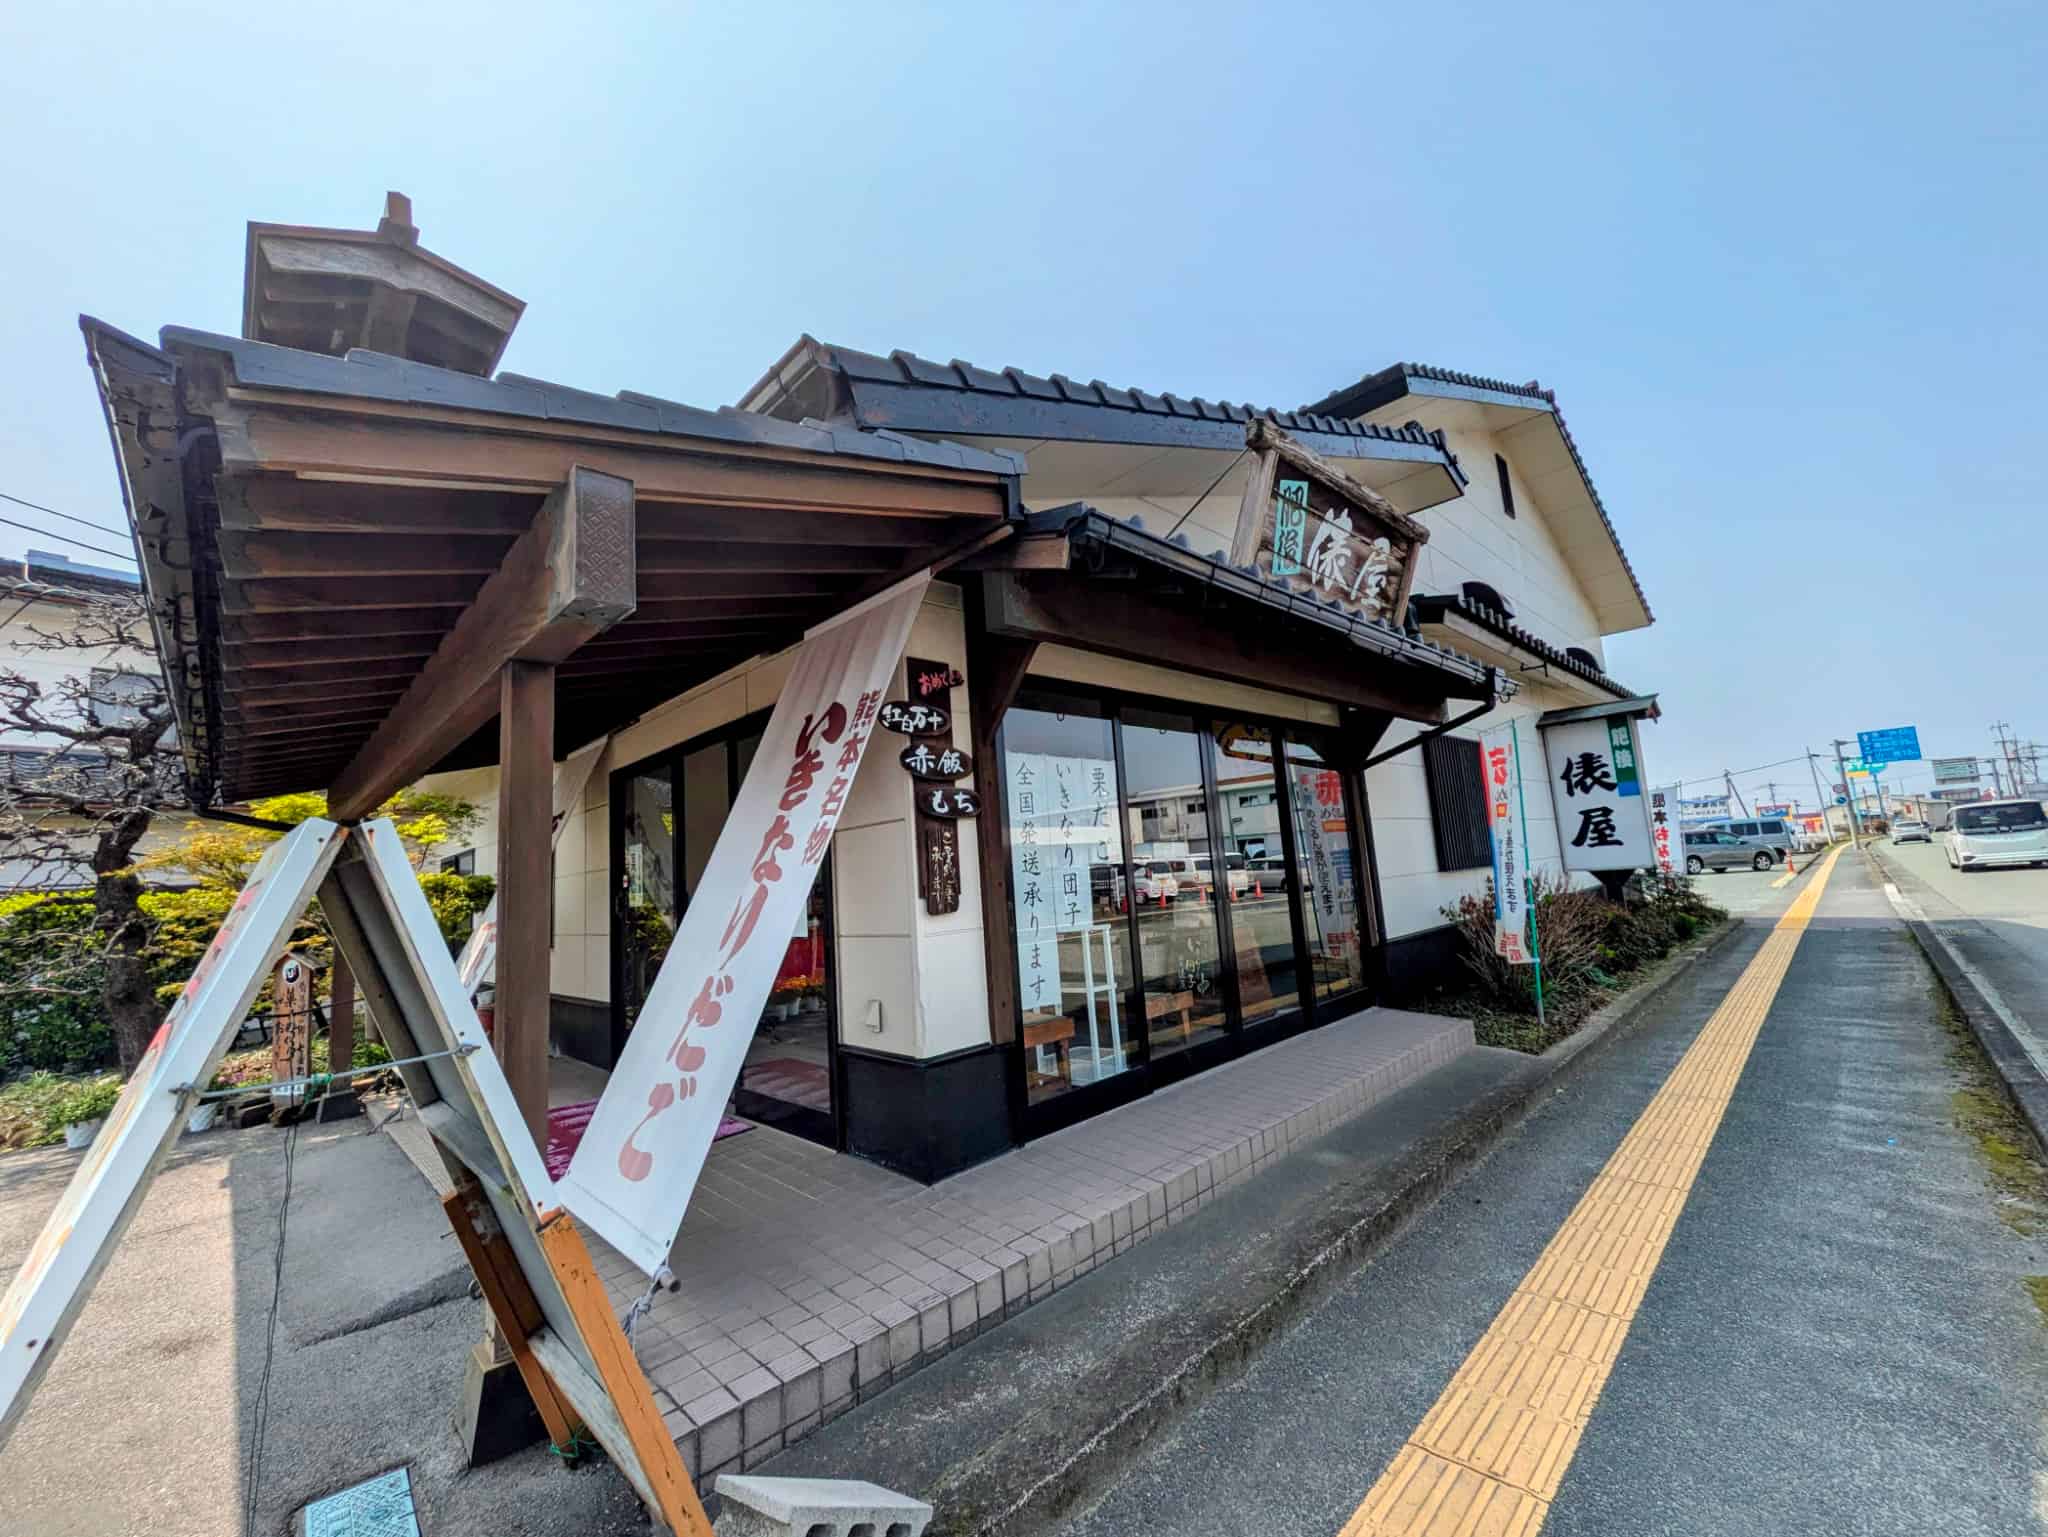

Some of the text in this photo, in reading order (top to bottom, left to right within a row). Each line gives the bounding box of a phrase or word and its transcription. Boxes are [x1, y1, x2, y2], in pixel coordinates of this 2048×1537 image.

[882, 704, 945, 733] 紅白万十
[905, 743, 965, 775] 赤飯
[1610, 727, 1634, 769] 肥後
[801, 689, 882, 866] 熊本名物
[930, 789, 974, 815] もち
[1560, 751, 1624, 848] 俵屋
[1016, 761, 1046, 1002] 全国発送承ります
[1056, 763, 1081, 926] いきなり団子
[619, 702, 846, 1184] いきなりだご
